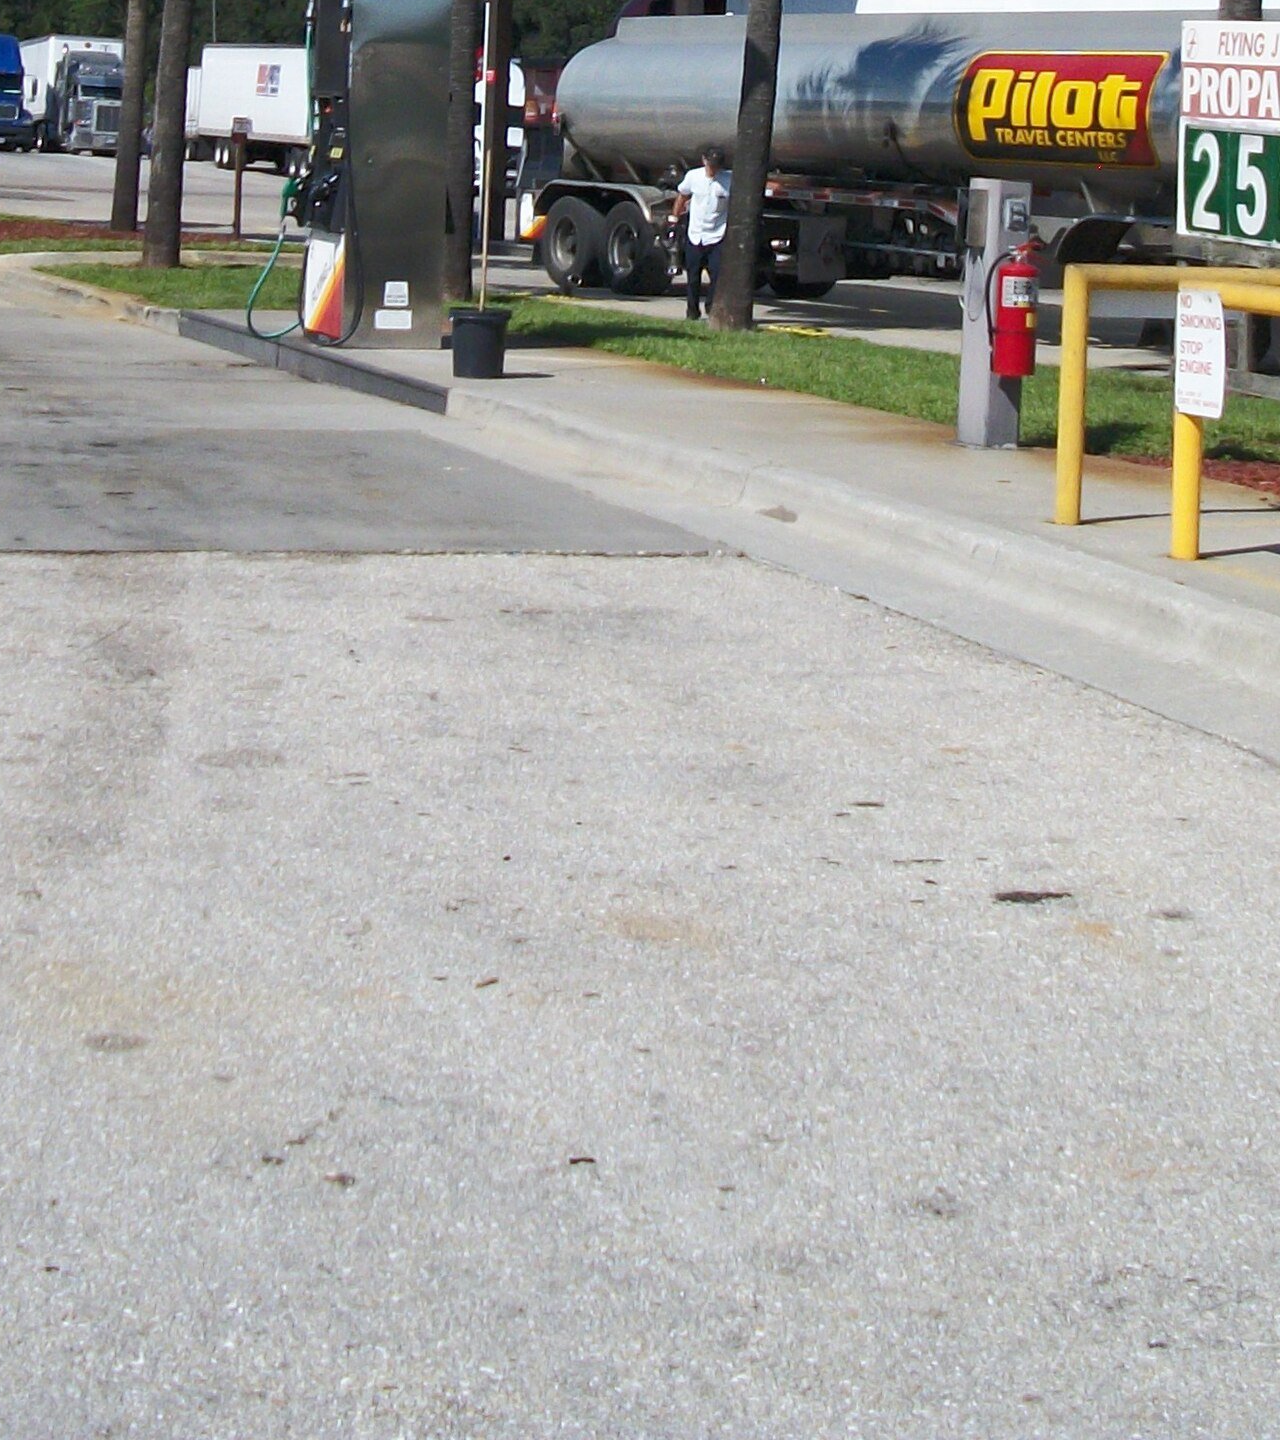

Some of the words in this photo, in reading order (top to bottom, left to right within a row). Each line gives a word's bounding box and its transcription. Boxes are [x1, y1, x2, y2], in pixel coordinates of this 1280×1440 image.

[1218, 31, 1265, 58] FLYING
[1270, 32, 1280, 58] J
[968, 68, 1143, 142] Pilot
[995, 127, 1053, 147] TRAVEL
[1055, 130, 1127, 149] CENTERS
[1180, 294, 1192, 309] NO
[1180, 314, 1222, 331] SMOKING
[1180, 340, 1203, 355] STOP
[1180, 359, 1213, 376] ENGINE
